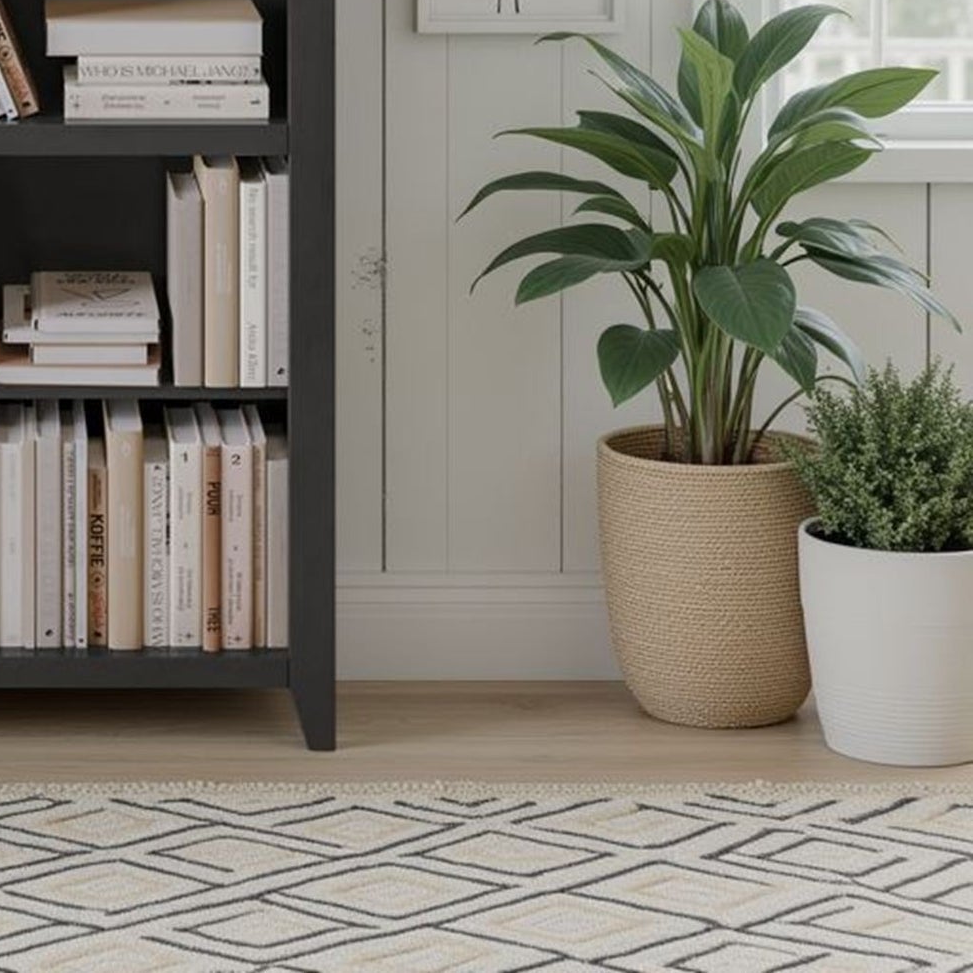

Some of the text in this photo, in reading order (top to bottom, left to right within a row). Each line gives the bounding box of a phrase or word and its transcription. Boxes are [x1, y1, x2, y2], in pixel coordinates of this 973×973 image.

[81, 65, 118, 78] WHO
[120, 65, 135, 78] IS
[137, 65, 198, 78] MICHAEL
[181, 452, 189, 464] 1
[230, 453, 242, 466] 2
[90, 513, 105, 568] KOFFIE
[151, 525, 164, 591] MICHAEL
[151, 607, 164, 646] WHO
